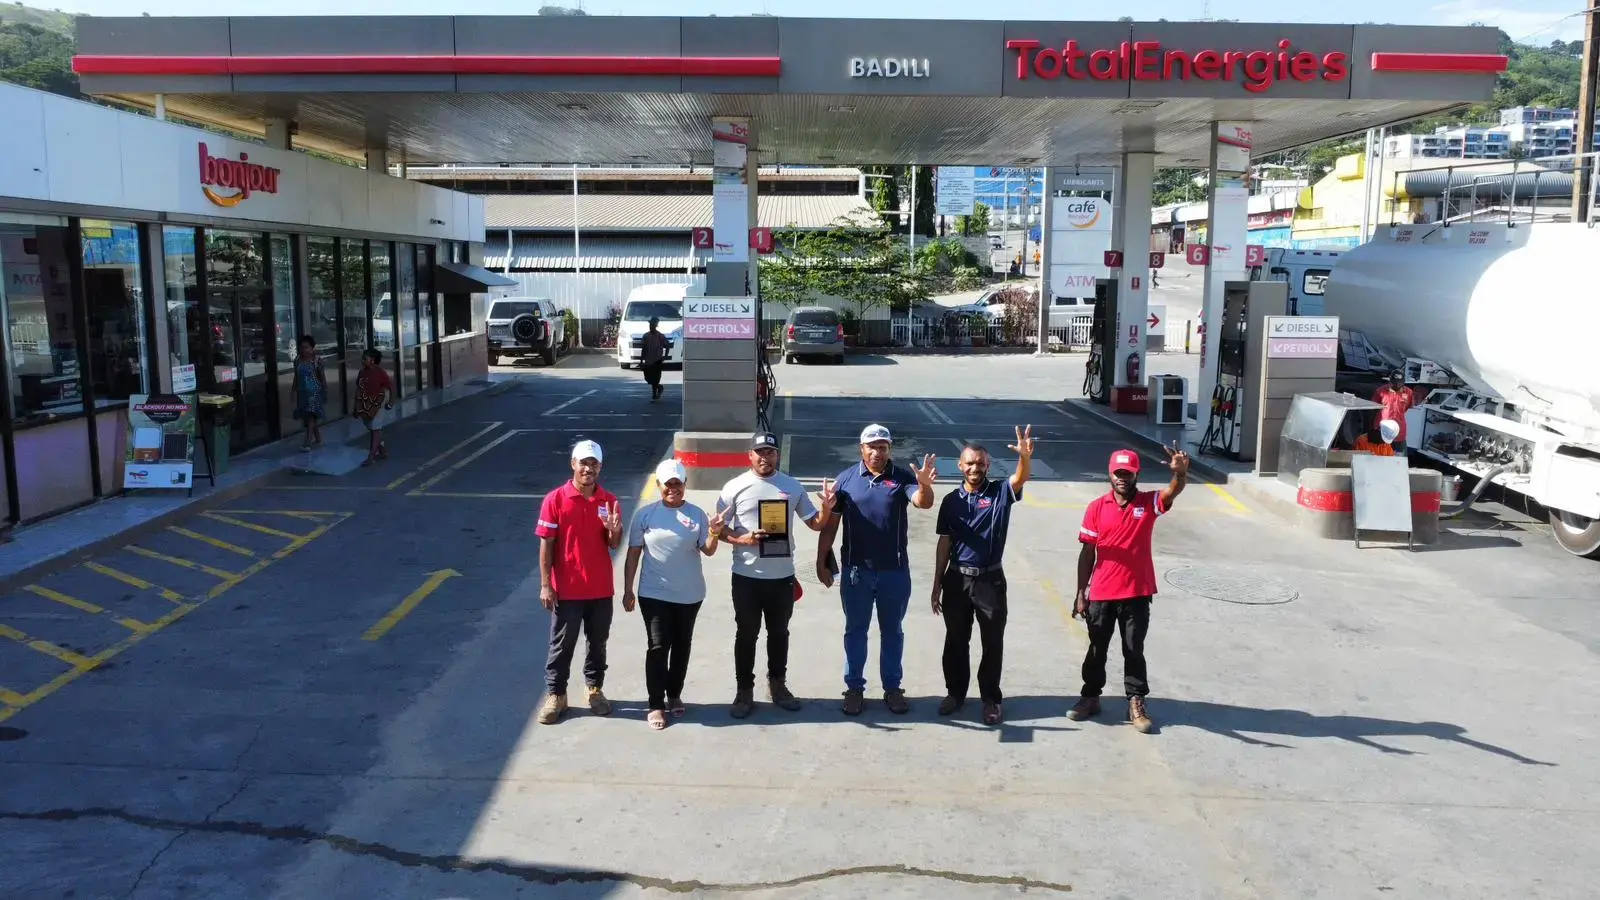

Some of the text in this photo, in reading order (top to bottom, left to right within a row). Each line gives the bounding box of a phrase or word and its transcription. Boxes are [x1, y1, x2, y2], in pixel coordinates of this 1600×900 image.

[851, 57, 930, 77] BADILI
[1006, 39, 1348, 92] TotalEnergies
[198, 142, 281, 200] bonjour
[1068, 200, 1096, 213] café
[699, 230, 709, 245] 2
[756, 231, 763, 245] 1
[1109, 253, 1117, 265] 7
[1152, 253, 1161, 266] 8
[1192, 247, 1203, 261] 6
[1248, 248, 1258, 262] 5
[1065, 275, 1096, 287] ATM
[701, 303, 738, 313] DIESEL
[699, 323, 740, 333] PETROL
[1287, 323, 1321, 333] DIESEL
[1283, 343, 1323, 353] PETROL
